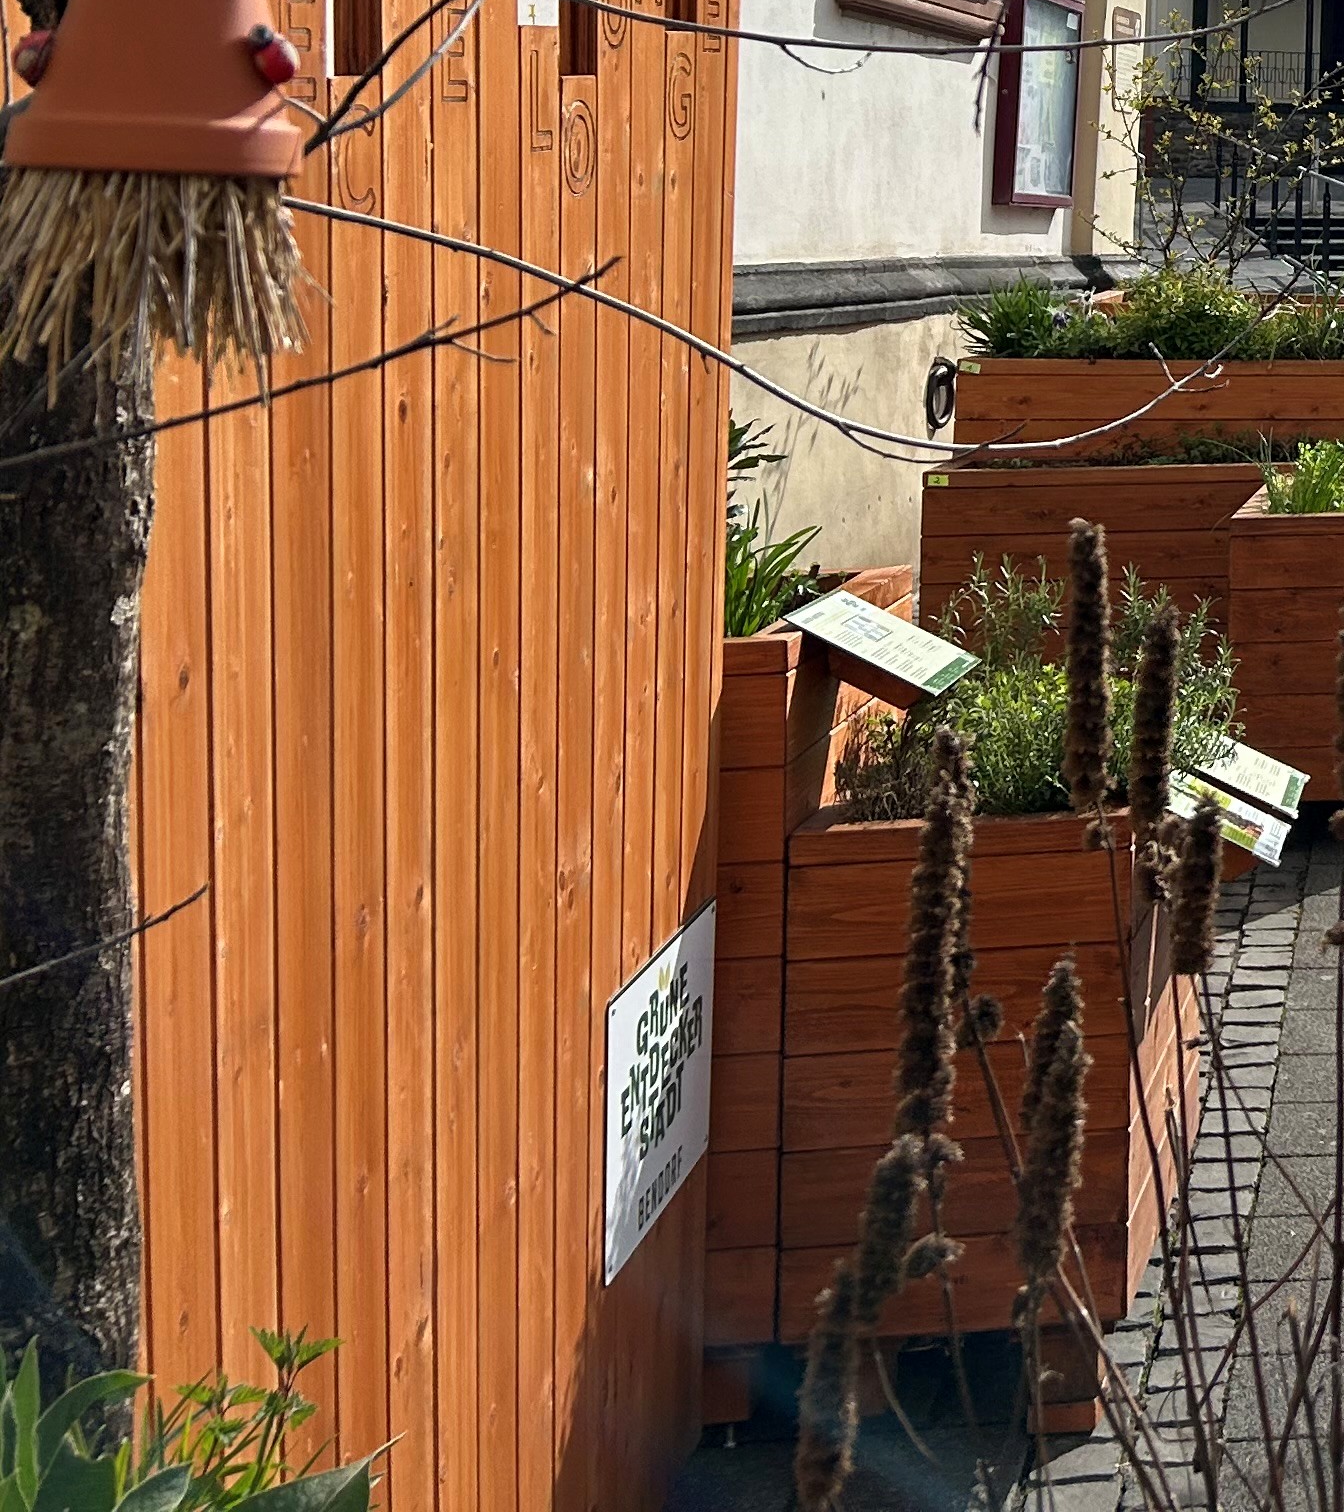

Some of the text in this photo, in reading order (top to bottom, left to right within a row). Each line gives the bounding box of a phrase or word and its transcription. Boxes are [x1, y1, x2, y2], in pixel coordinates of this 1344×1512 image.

[620, 994, 703, 1140] ENTDECKER
[639, 1060, 685, 1162] STADT
[637, 1144, 683, 1231] BENDORF
